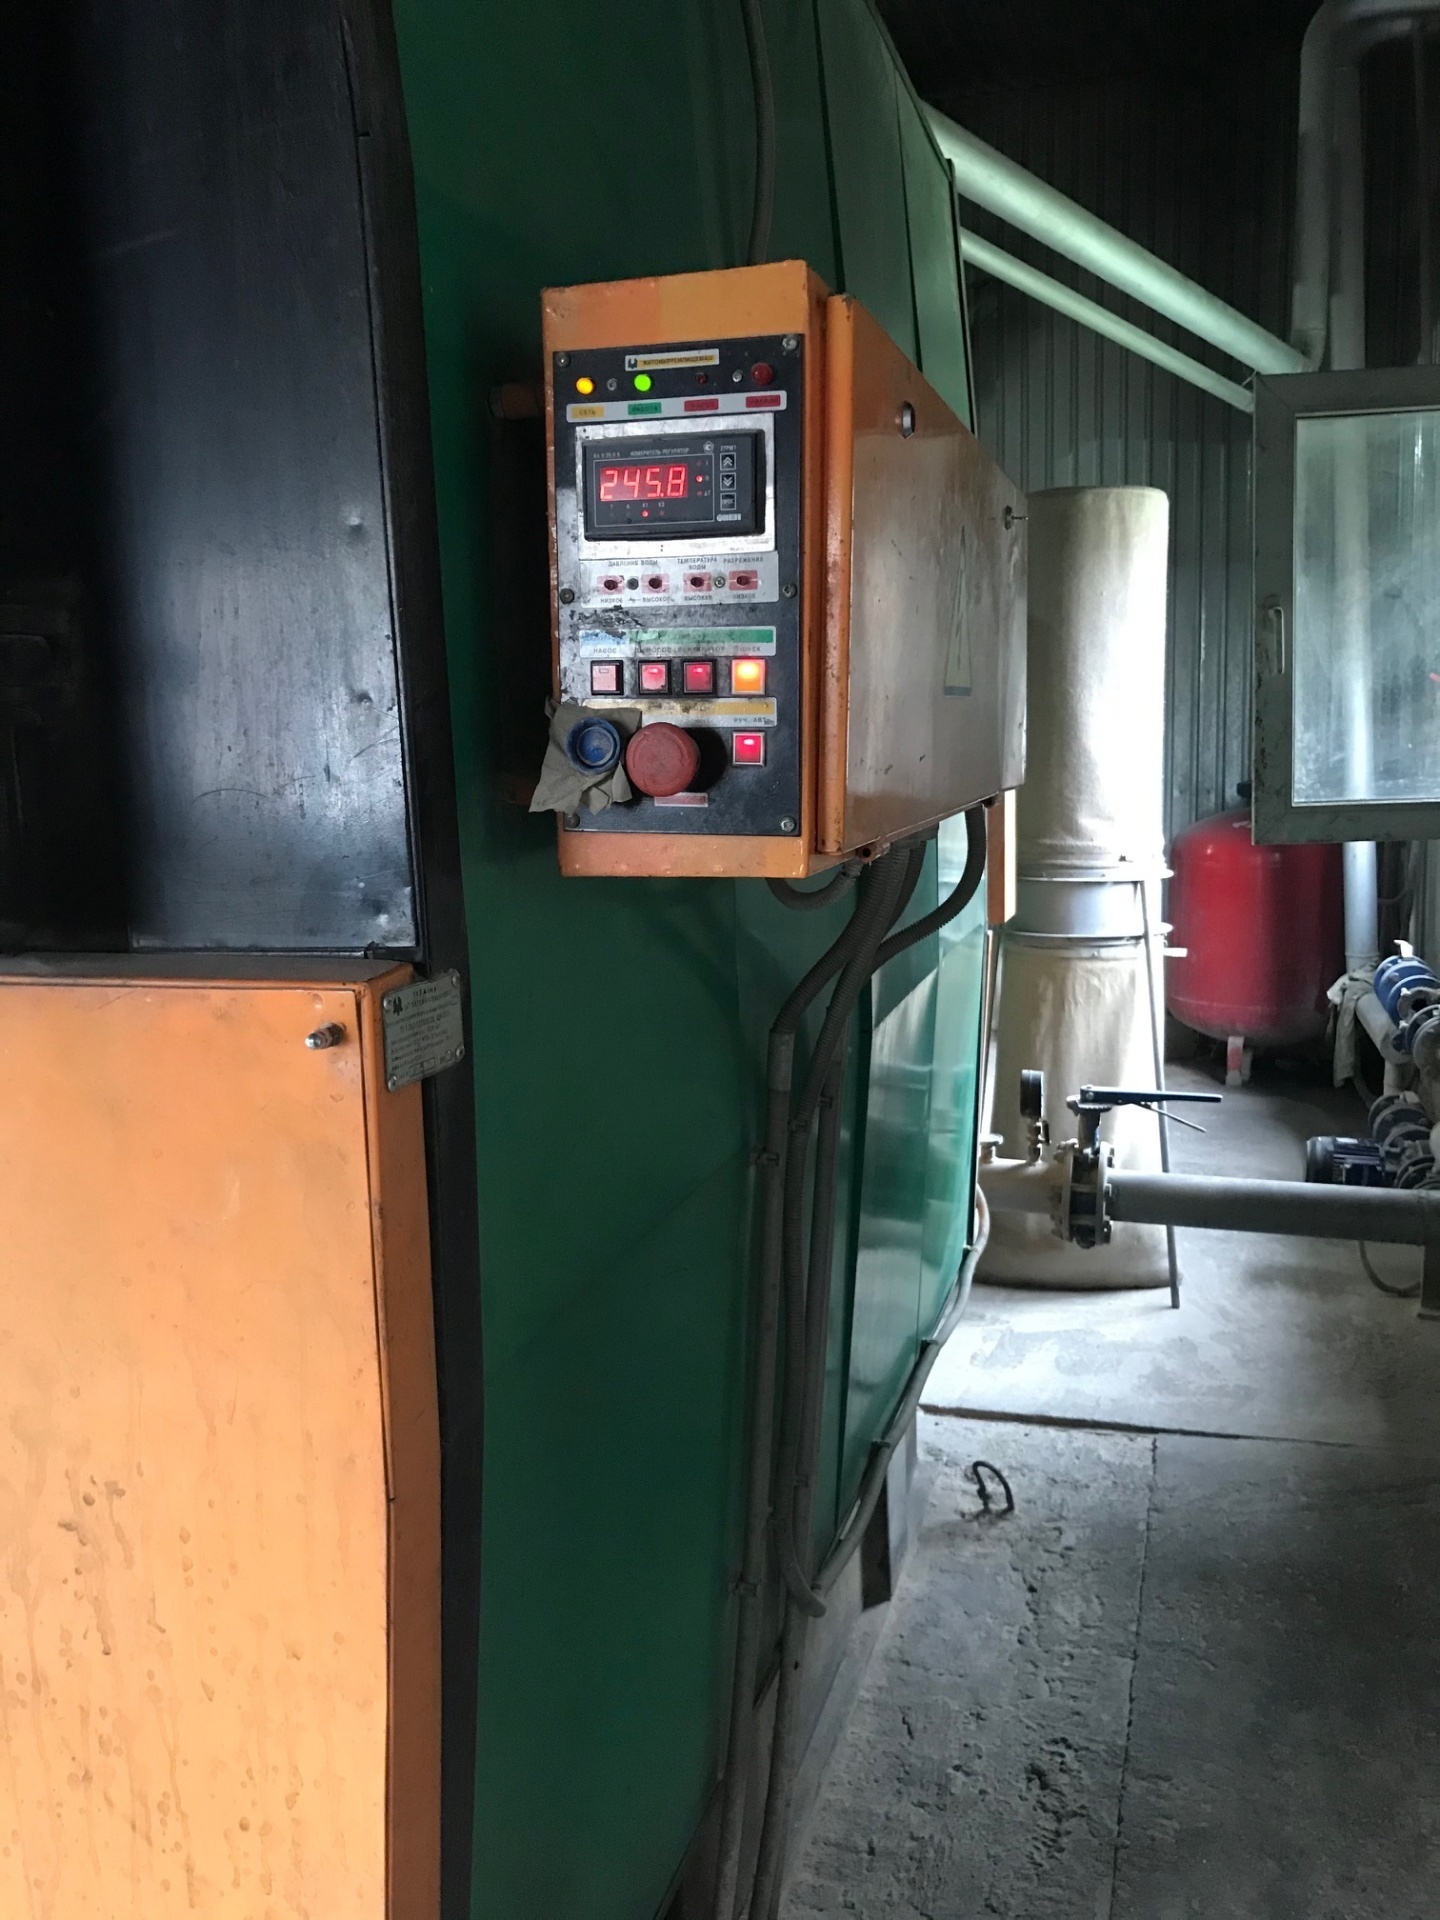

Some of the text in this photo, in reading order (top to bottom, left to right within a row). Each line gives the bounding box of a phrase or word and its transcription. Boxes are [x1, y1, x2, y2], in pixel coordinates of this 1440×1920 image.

[600, 466, 686, 500] 245.8
[677, 557, 718, 565] ТЕМПЕРАТУРА
[723, 556, 764, 564] РАЗРЕЖЕНИЕ
